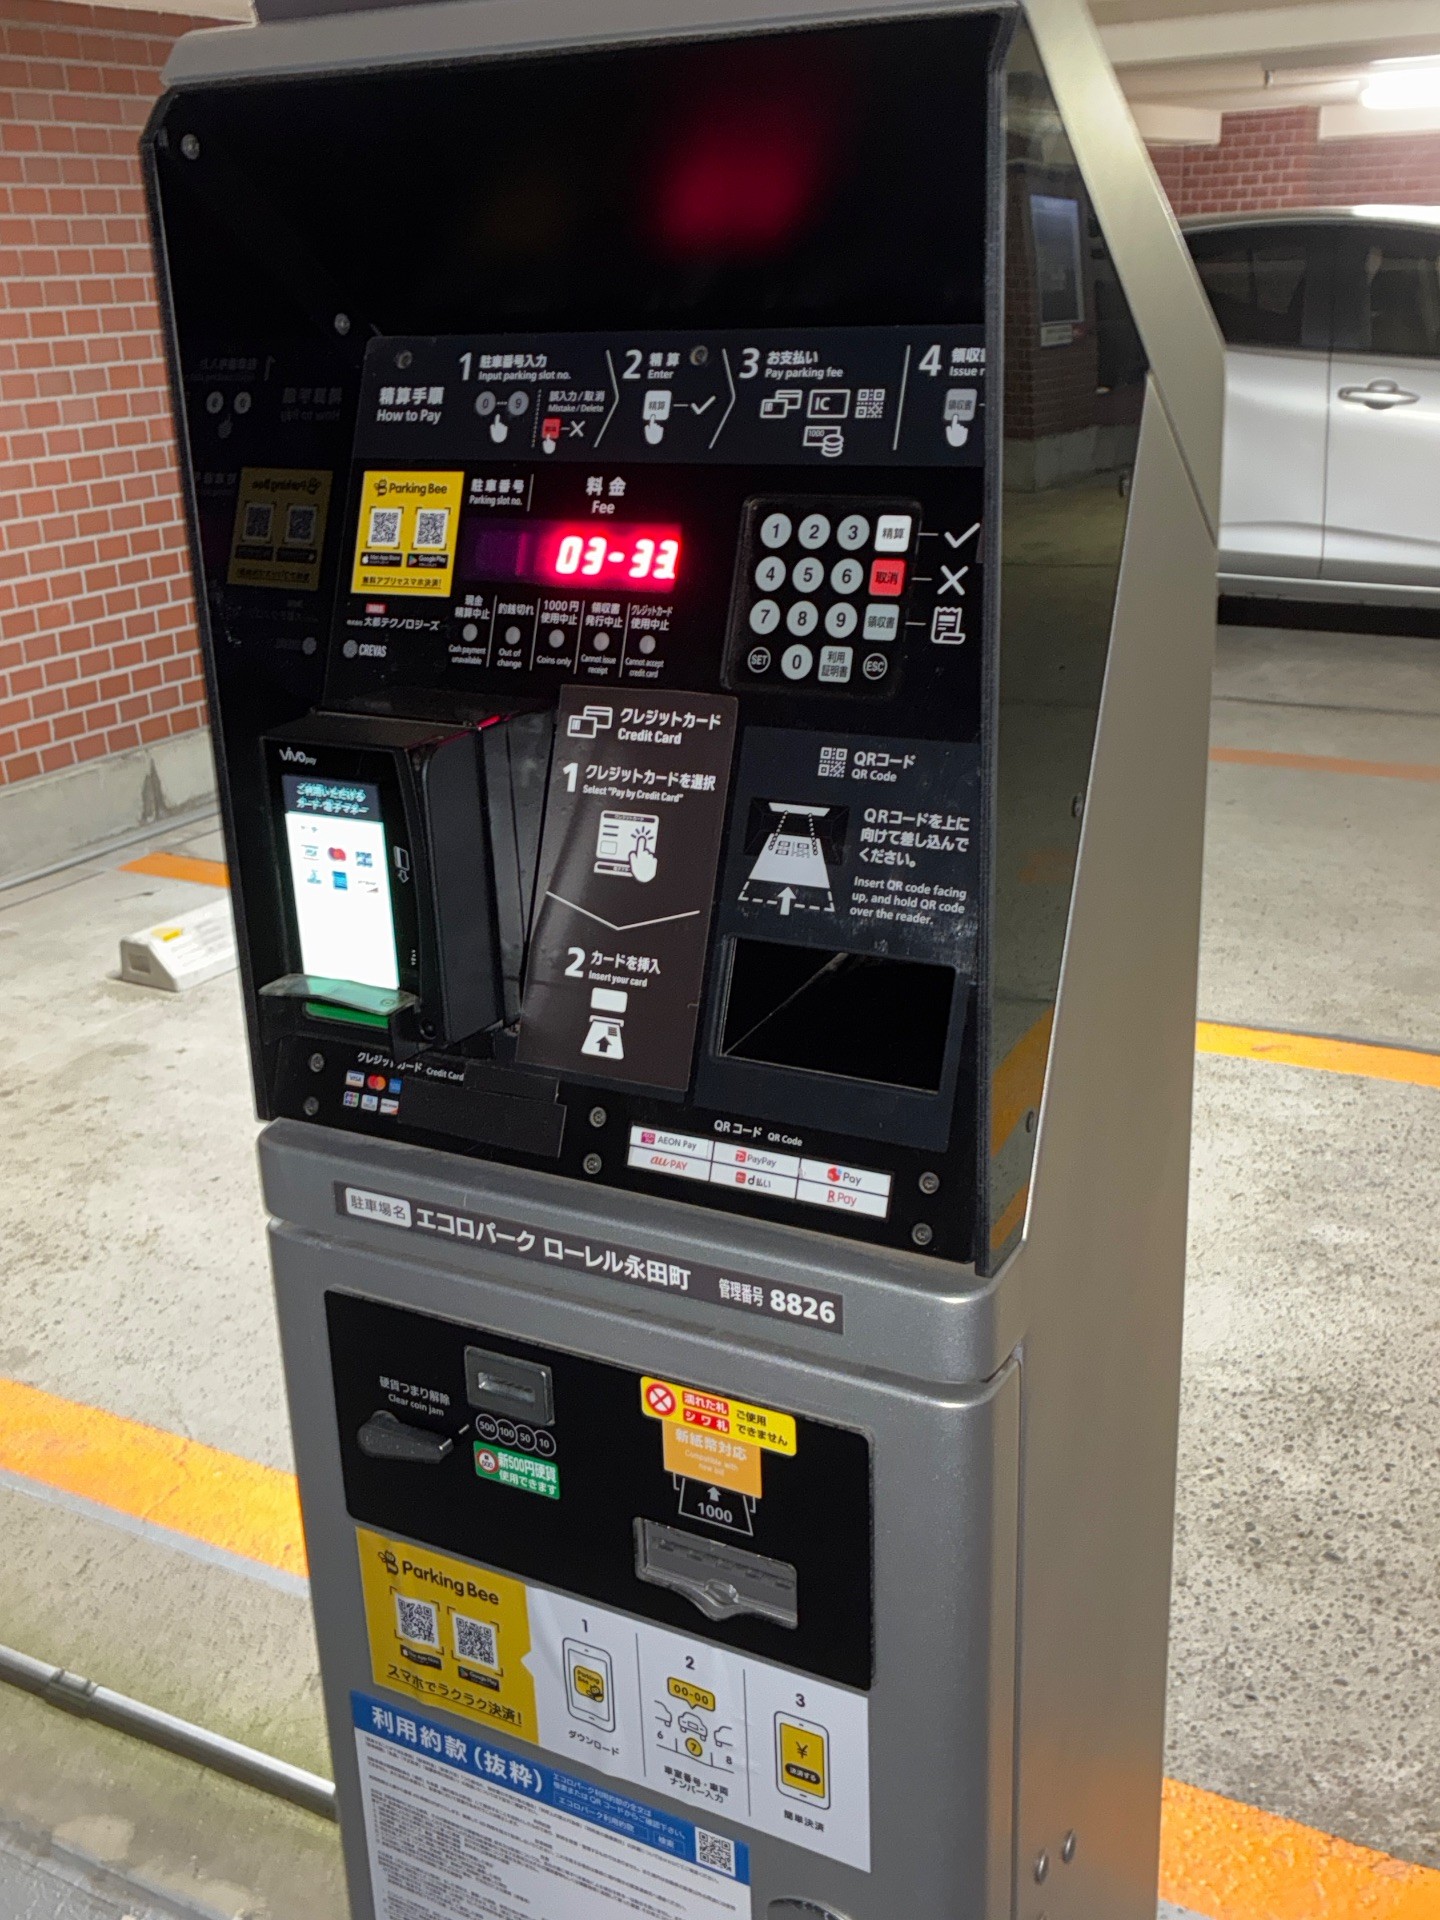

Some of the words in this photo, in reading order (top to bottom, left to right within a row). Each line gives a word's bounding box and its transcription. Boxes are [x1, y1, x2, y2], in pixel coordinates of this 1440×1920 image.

[479, 354, 547, 368] 駐車番号入力
[622, 349, 643, 380] 2
[649, 353, 680, 367] 精算
[739, 348, 760, 378] 3
[767, 351, 819, 365] お支払い
[918, 344, 942, 377] 4
[458, 352, 472, 381] 1
[647, 369, 673, 379] Enter
[765, 367, 783, 379] Pay
[784, 367, 824, 380] parking
[826, 367, 844, 378] fee
[949, 366, 977, 376] Issue
[478, 370, 502, 381] Input
[503, 370, 537, 382] parking
[538, 370, 555, 380] slot
[556, 371, 571, 380] no.
[378, 387, 444, 406] 精算手順
[814, 396, 830, 411] IC
[376, 409, 403, 422] How
[405, 411, 418, 422] to
[420, 411, 442, 424] Pay
[389, 482, 426, 496] Parking
[428, 482, 448, 495] Bee
[470, 478, 525, 494] 駐車番号
[585, 476, 627, 497] 料金
[469, 494, 496, 507] Parking
[591, 500, 615, 515] Fee
[772, 524, 780, 538] 1
[808, 524, 820, 539] 2
[848, 526, 858, 540] 3
[882, 527, 905, 540] 精算
[766, 567, 776, 582] 4
[802, 567, 814, 582] 5
[842, 569, 852, 584] 6
[875, 572, 898, 585] 取消
[540, 612, 578, 626] 使用中止
[584, 614, 623, 629] 発行中止
[760, 609, 770, 624] 7
[797, 611, 808, 626] 8
[836, 612, 846, 627] 9
[868, 616, 896, 630] 領収書
[630, 617, 670, 632] 使用中止
[498, 648, 512, 657] Out
[512, 648, 522, 657] of
[827, 652, 846, 664] 利用
[496, 660, 522, 670] change
[536, 655, 554, 664] Coins
[555, 656, 572, 668] only
[751, 655, 768, 666] SET
[792, 654, 802, 670] 0
[866, 660, 885, 673] ESC
[821, 664, 848, 678] 証明書
[620, 708, 722, 731] クレジットカード
[618, 728, 652, 742] Credit
[654, 730, 682, 745] Card
[854, 751, 916, 770] QRコード
[562, 762, 578, 793] 1
[585, 764, 717, 792] クレジットカードを選択
[851, 768, 868, 780] QR
[870, 770, 897, 782] Code
[582, 784, 606, 796] Select
[626, 788, 636, 800] by
[636, 790, 660, 801] Credit
[864, 808, 970, 832] QRコードを上に
[860, 828, 970, 853] 向けて差し込んで
[859, 847, 916, 868] ください。
[854, 876, 885, 890] Insert
[886, 880, 903, 892] QR
[904, 882, 931, 896] code
[932, 885, 968, 902] facing
[852, 892, 868, 906] up,
[870, 892, 892, 906] and
[892, 894, 918, 908] hold
[919, 898, 937, 911] QR
[938, 900, 966, 914] code
[850, 906, 874, 920] over
[875, 908, 894, 921] the
[895, 910, 934, 926] reader.
[564, 946, 586, 978] 2
[590, 950, 661, 974] カードを挿入
[588, 970, 612, 982] Insert
[612, 974, 630, 985] your
[630, 976, 648, 988] card
[426, 1067, 447, 1078] Credit
[448, 1070, 465, 1082] Card
[657, 1136, 682, 1148] AEON
[682, 1139, 698, 1151] Pay
[768, 1132, 780, 1144] QR
[782, 1134, 804, 1146] Code
[650, 1156, 670, 1167] au
[670, 1160, 688, 1172] PAY
[746, 1152, 777, 1168] PayPay
[842, 1171, 862, 1186] Pay
[837, 1193, 858, 1207] Pay
[350, 1195, 406, 1221] 駐車場名
[416, 1208, 536, 1252] エコロパーク
[544, 1237, 692, 1291] ローレル永田町
[718, 1278, 764, 1308] 管理番号
[770, 1289, 836, 1324] 8826
[379, 1376, 450, 1406] 硬貨つまり解除
[388, 1393, 408, 1406] Clear
[410, 1399, 428, 1411] coin
[428, 1404, 445, 1417] jam
[685, 1411, 729, 1432] シワ札
[736, 1409, 767, 1426] ご使用
[479, 1422, 495, 1433] 500
[500, 1427, 514, 1438] 100
[736, 1423, 788, 1447] できません
[520, 1432, 531, 1443] 50
[539, 1438, 550, 1448] 10
[676, 1428, 748, 1461] 新紙幣対応
[498, 1452, 556, 1484] 新500円硬貨
[500, 1470, 558, 1495] 使用できます
[698, 1502, 733, 1523] 1000
[402, 1560, 465, 1596] Parking
[467, 1582, 500, 1605] Bee
[582, 1618, 588, 1633] 1
[685, 1656, 696, 1670] 2
[388, 1664, 523, 1725] スマホでラクラク決済!
[796, 1693, 806, 1708] 3
[656, 1730, 664, 1740] 6
[568, 1730, 620, 1756] ダウンロード
[690, 1742, 697, 1752] 7
[726, 1756, 732, 1766] 8
[670, 1778, 724, 1804] ナンバー入力
[783, 1808, 826, 1833] 簡単決済
